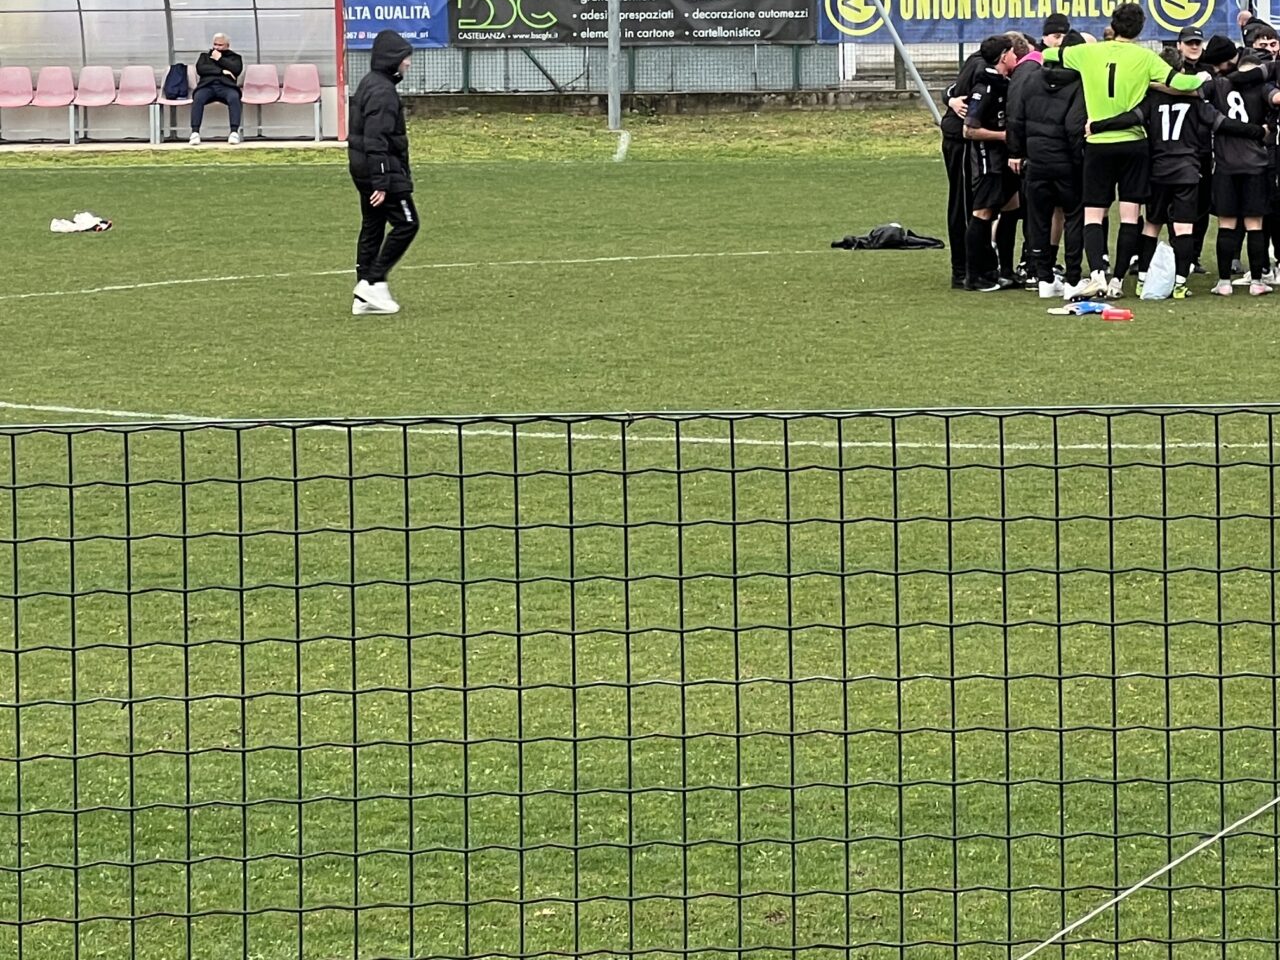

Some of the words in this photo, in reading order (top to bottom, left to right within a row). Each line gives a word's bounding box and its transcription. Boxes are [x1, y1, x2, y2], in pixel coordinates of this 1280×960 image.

[375, 2, 431, 20] QUALITÀ
[619, 10, 674, 21] prespaziati
[692, 8, 755, 19] decorazione
[758, 8, 809, 18] automezzi
[458, 32, 505, 40] CASTELLANZA
[624, 28, 634, 38] in
[637, 28, 675, 38] cartone
[692, 27, 761, 38] cartellonistica
[1106, 62, 1117, 98] 1
[1227, 91, 1249, 124] 8
[1158, 103, 1191, 141] 17
